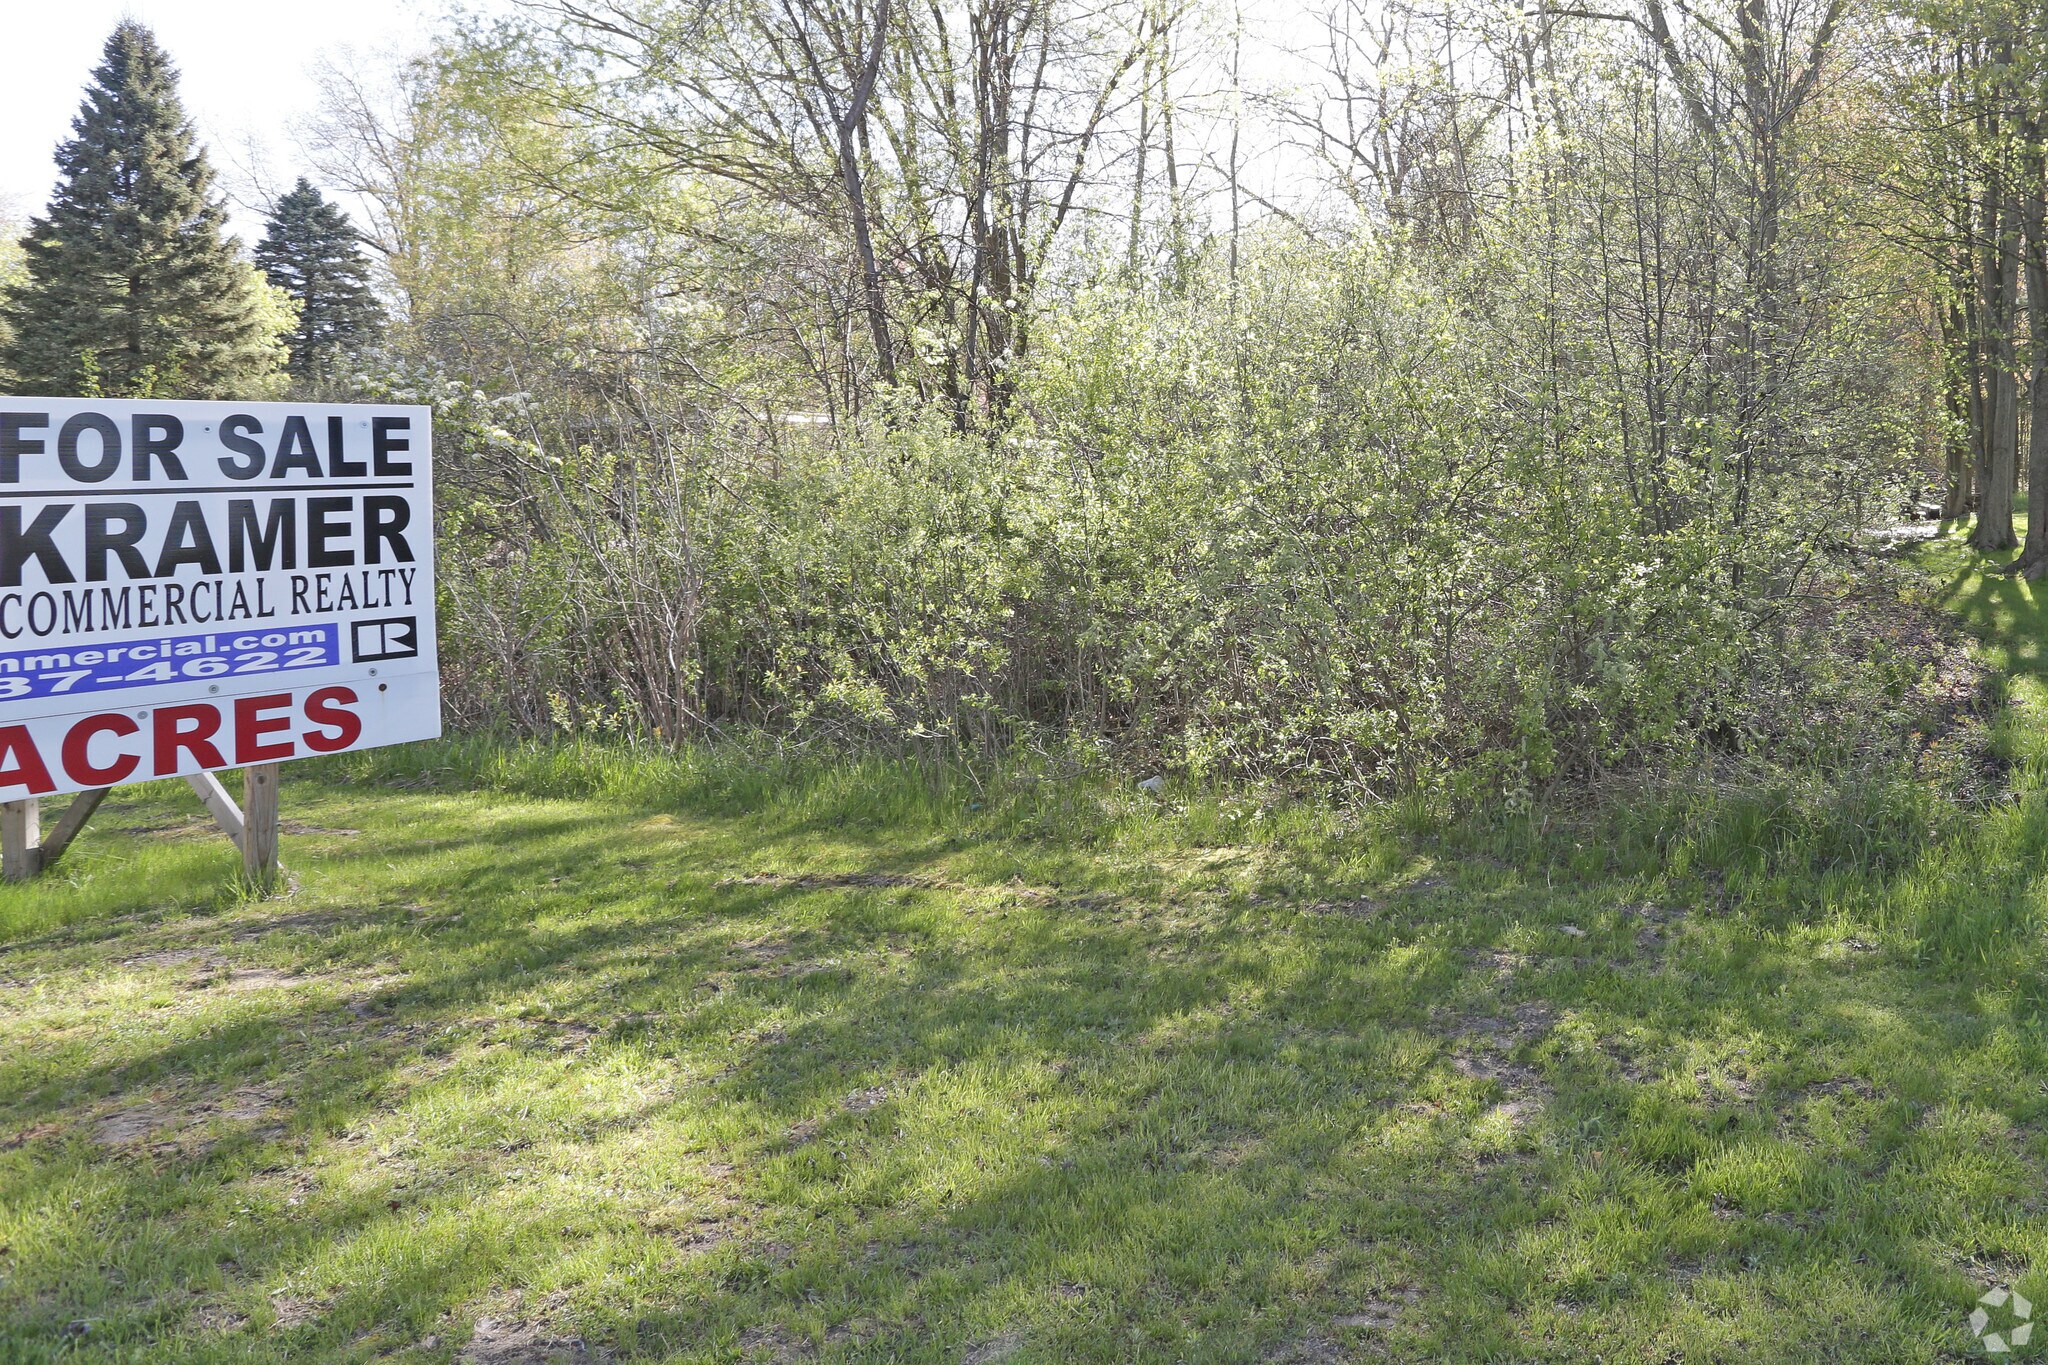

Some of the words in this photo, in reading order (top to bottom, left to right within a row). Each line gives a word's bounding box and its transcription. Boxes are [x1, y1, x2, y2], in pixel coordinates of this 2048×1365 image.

[0, 412, 189, 483] FOR
[217, 414, 413, 480] SALE
[0, 495, 416, 587] KRAMER
[2, 579, 275, 639] COMMERCIAL
[291, 568, 416, 615] REALTY
[0, 686, 363, 795] ACRES
